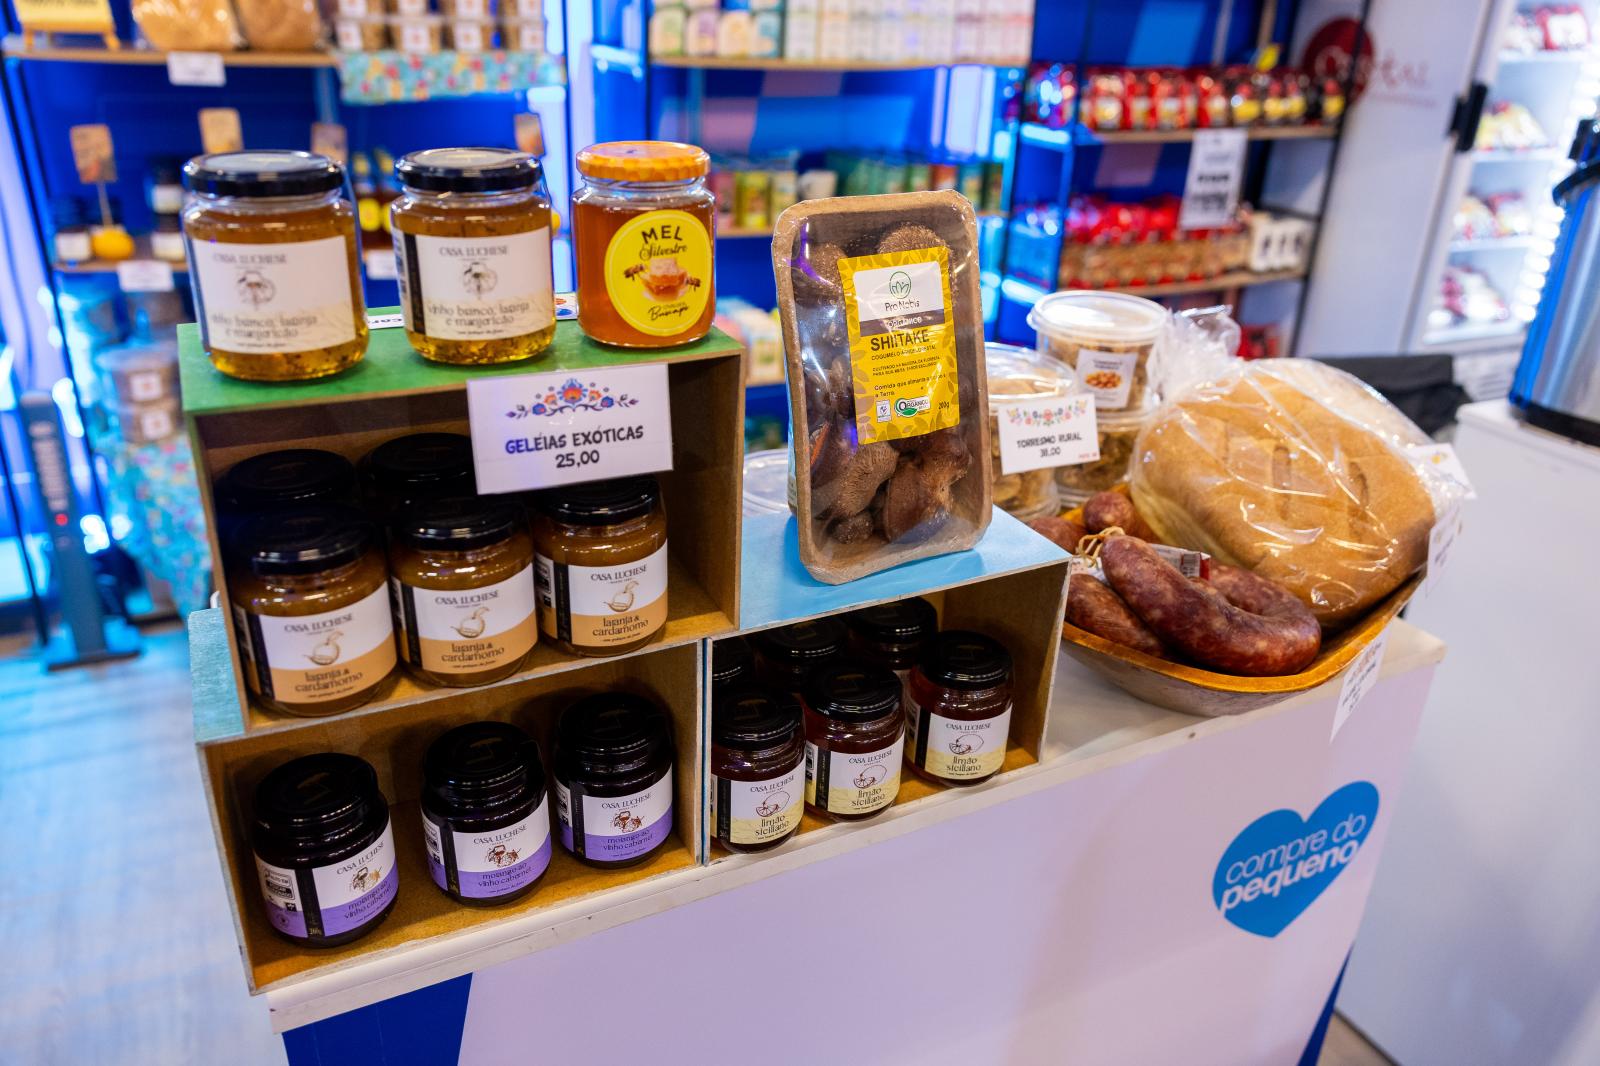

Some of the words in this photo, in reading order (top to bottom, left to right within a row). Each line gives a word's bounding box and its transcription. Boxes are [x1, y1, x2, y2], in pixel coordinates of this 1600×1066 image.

[641, 224, 683, 245] MEL
[439, 247, 464, 258] CASA
[639, 242, 688, 262] Silvestre
[884, 302, 897, 312] Pro
[898, 298, 920, 310] Nobis
[870, 328, 930, 352] SHIITAKE
[872, 350, 901, 361] COGUMELO
[874, 383, 896, 391] Comida
[505, 431, 568, 455] GELÉIAS
[572, 424, 645, 448] EXÓTICAS
[1058, 432, 1082, 442] RURAL
[554, 449, 601, 470] 25,00
[590, 573, 612, 581] CASA
[614, 564, 648, 580] LUCHESE
[434, 596, 458, 605] CASA
[460, 590, 499, 604] LUCHESE
[284, 624, 310, 632] CASA
[312, 612, 354, 630] LUCHESE
[592, 620, 649, 636] cardamomo
[603, 616, 633, 628] laranja
[441, 646, 506, 662] cardamomo
[294, 672, 364, 692] cardamomo
[964, 722, 992, 731] LUCHESE
[868, 750, 892, 763] LUCHESE
[953, 756, 978, 765] limão
[769, 775, 794, 790] LUCHESE
[622, 792, 650, 807] LUCHESE
[851, 794, 886, 806] siciliano
[858, 788, 882, 798] limão
[755, 820, 790, 836] siciliano
[761, 816, 786, 828] limão
[495, 824, 528, 842] LUCHESE
[624, 834, 653, 849] cabernet
[1225, 828, 1328, 885] compre
[1332, 812, 1368, 844] do
[336, 862, 357, 875] CASA
[358, 840, 384, 865] LUCHESE
[518, 862, 528, 870] ao
[478, 879, 500, 888] vinho
[500, 866, 532, 884] cabernet
[1219, 839, 1360, 918] pequeno
[344, 906, 366, 920] vinho
